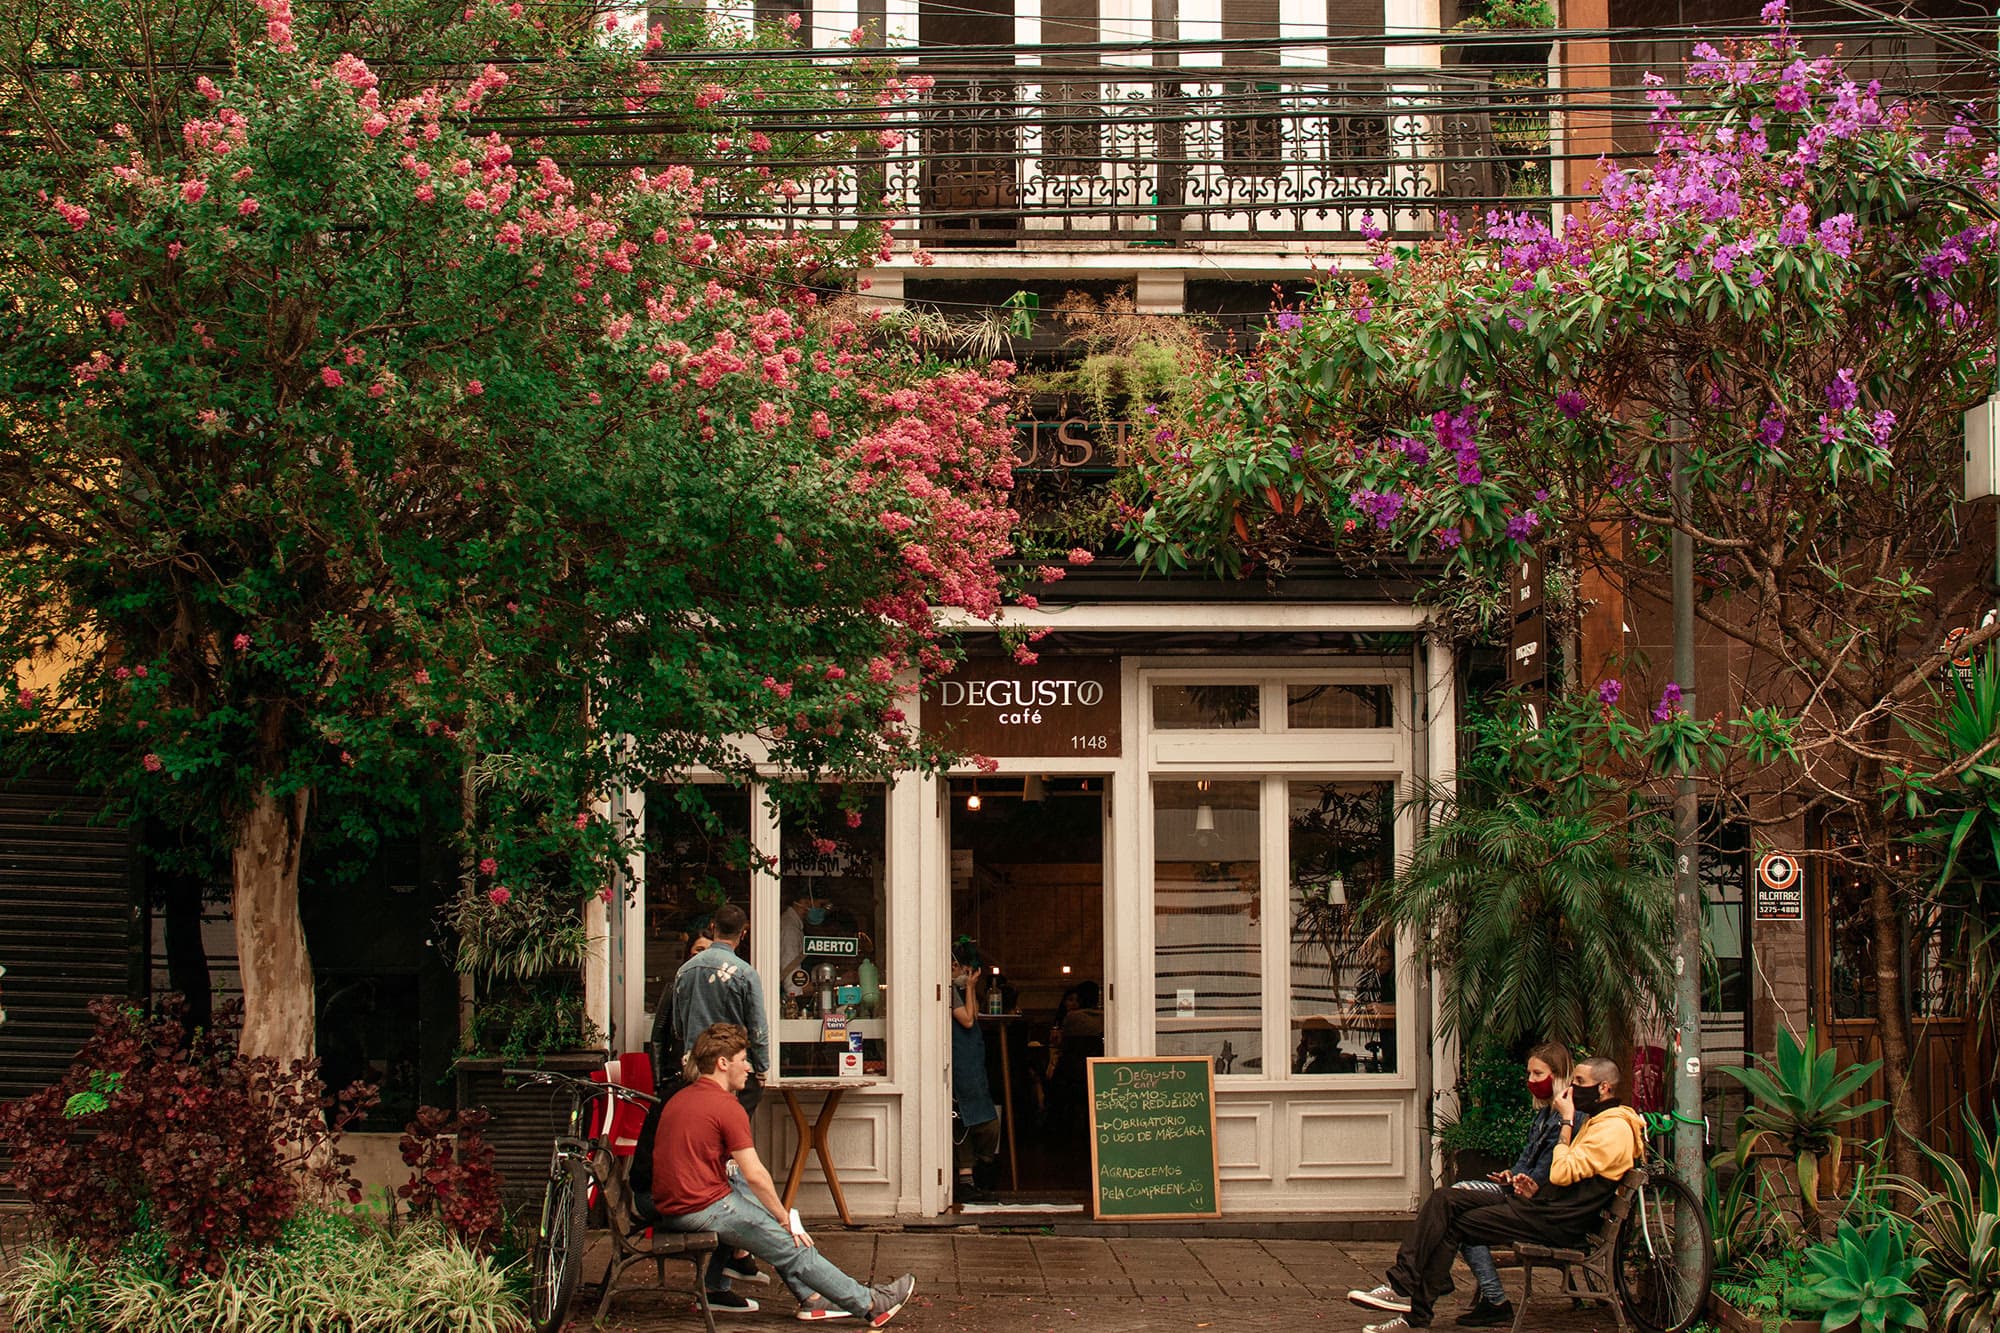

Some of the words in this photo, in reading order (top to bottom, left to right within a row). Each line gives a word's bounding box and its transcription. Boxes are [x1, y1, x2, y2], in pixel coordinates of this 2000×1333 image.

[941, 680, 1104, 706] DEGUSTO
[999, 708, 1042, 724] café
[1071, 735, 1107, 750] 1148
[1759, 891, 1800, 901] ALCATRAZ
[807, 940, 854, 953] ABERTO
[1096, 1100, 1138, 1113] ESPAÇO
[1142, 1099, 1198, 1111] REDUZIDO
[1112, 1115, 1187, 1131] OBRIGATÓRIO
[1112, 1133, 1135, 1143] USO
[1137, 1131, 1153, 1142] DE
[1100, 1164, 1183, 1179] AGRADECEMOS
